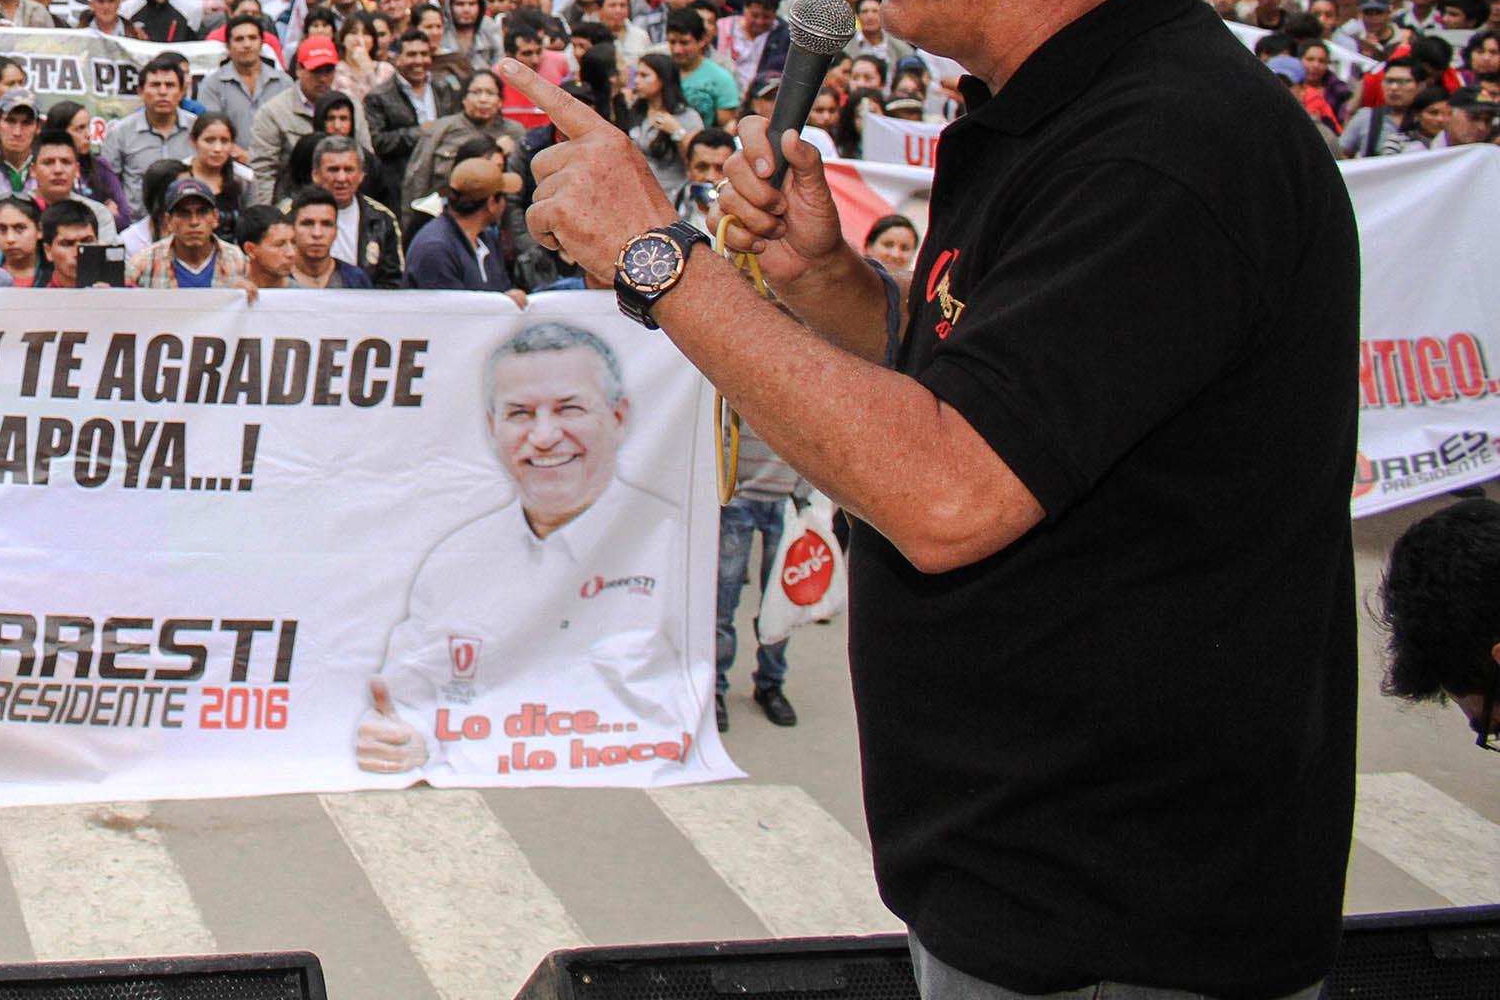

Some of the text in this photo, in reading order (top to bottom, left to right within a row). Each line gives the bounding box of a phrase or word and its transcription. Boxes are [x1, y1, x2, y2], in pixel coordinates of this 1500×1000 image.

[20, 330, 88, 400] TE
[94, 336, 429, 406] AGRADECE
[1382, 447, 1494, 494] PRESIDENTE
[198, 686, 290, 731] 2016
[434, 702, 638, 742] Lo dice...
[498, 731, 694, 774] ¡lo hace!
